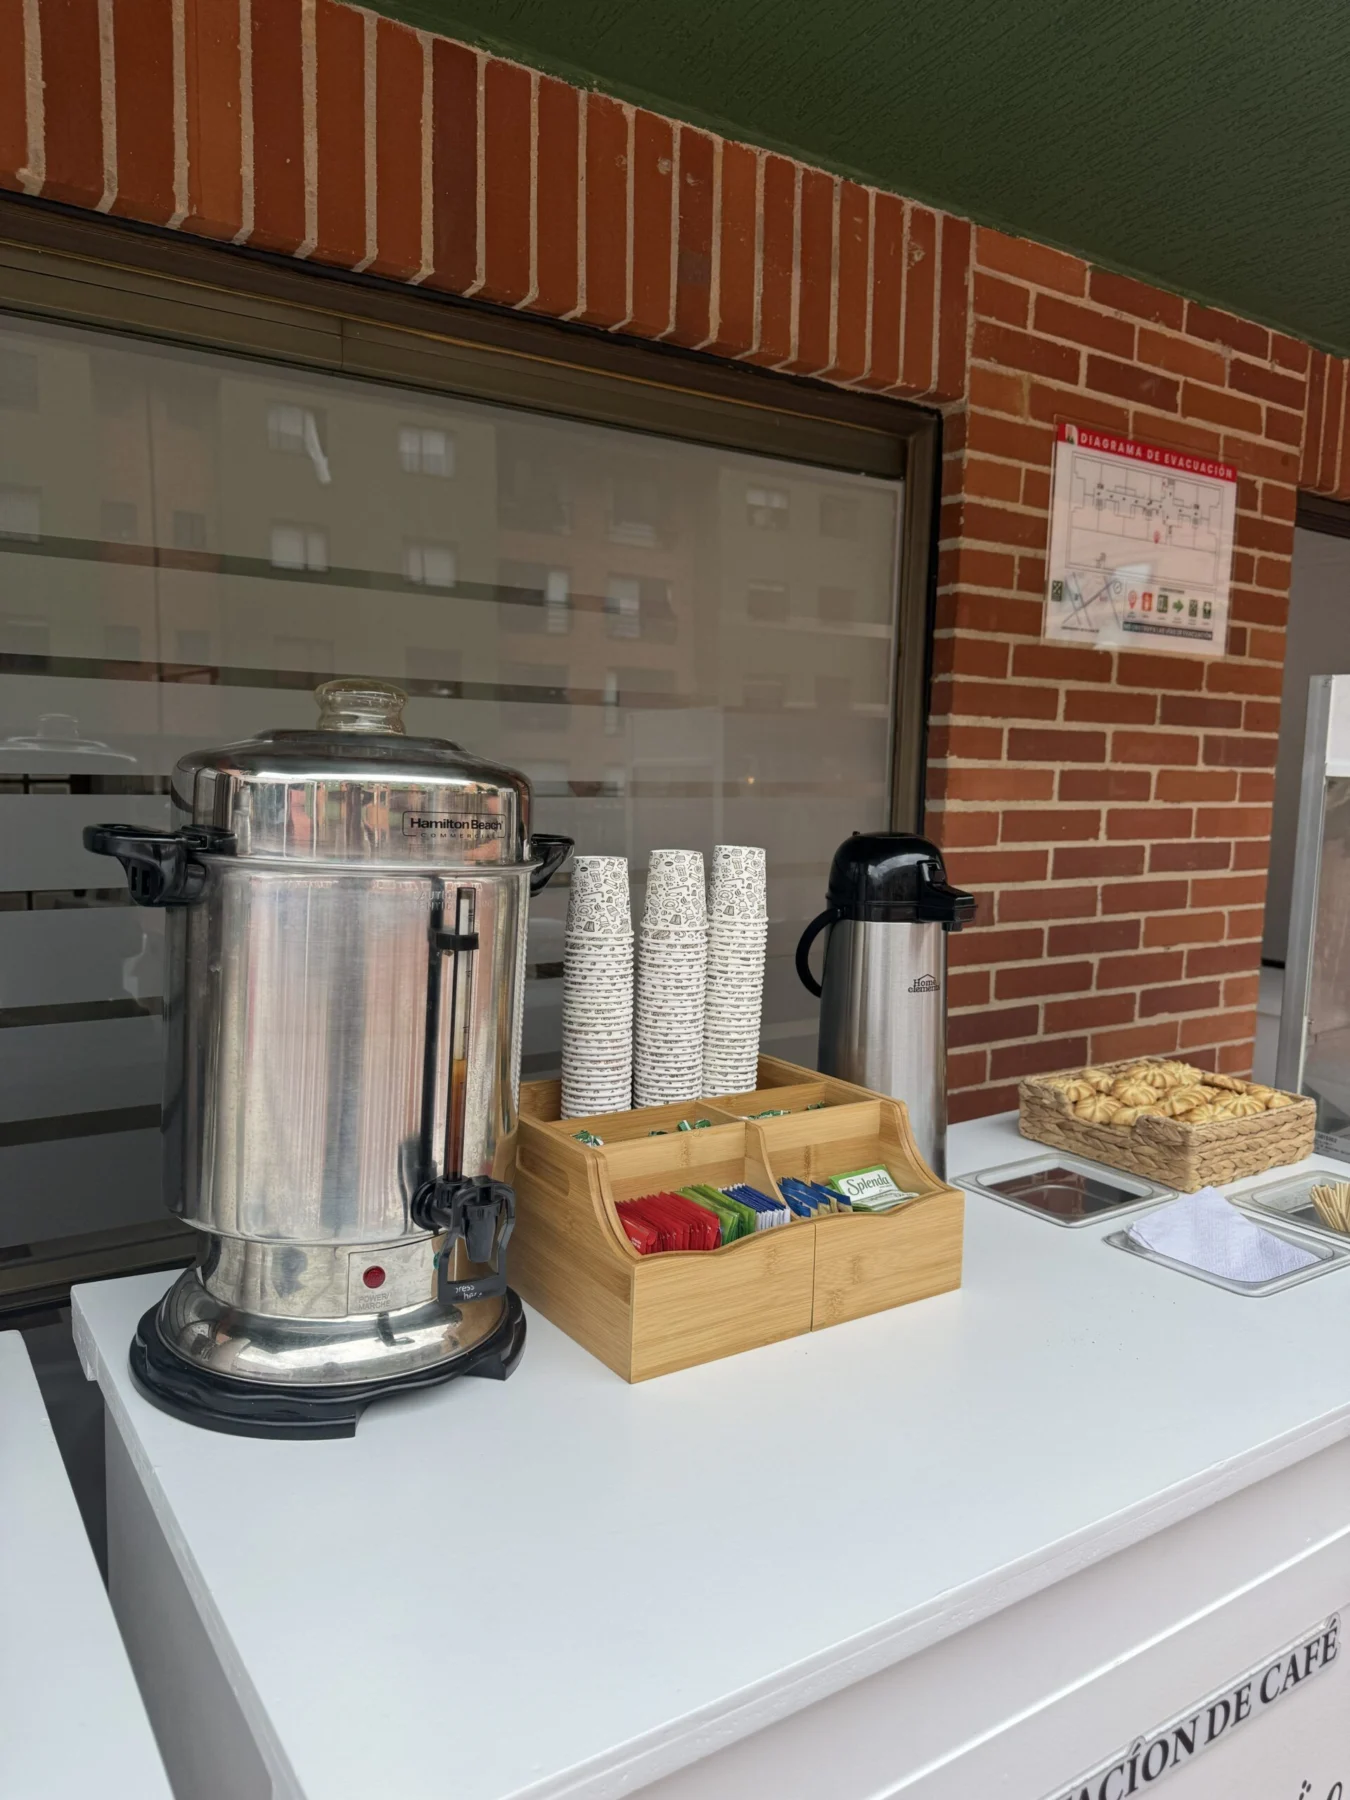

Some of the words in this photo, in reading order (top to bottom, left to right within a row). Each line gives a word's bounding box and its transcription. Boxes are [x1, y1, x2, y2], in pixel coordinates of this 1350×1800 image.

[1080, 433, 1142, 457] DIAGRAMA
[1147, 449, 1160, 462] DE
[1164, 455, 1233, 479] EVACUACIÓN
[410, 817, 470, 829] Hamilton
[471, 819, 502, 831] Beach
[846, 1174, 890, 1196] Splenda
[358, 1300, 391, 1311] MARCHE
[1203, 1682, 1252, 1745] DE
[1259, 1618, 1338, 1704] CAFÉ
